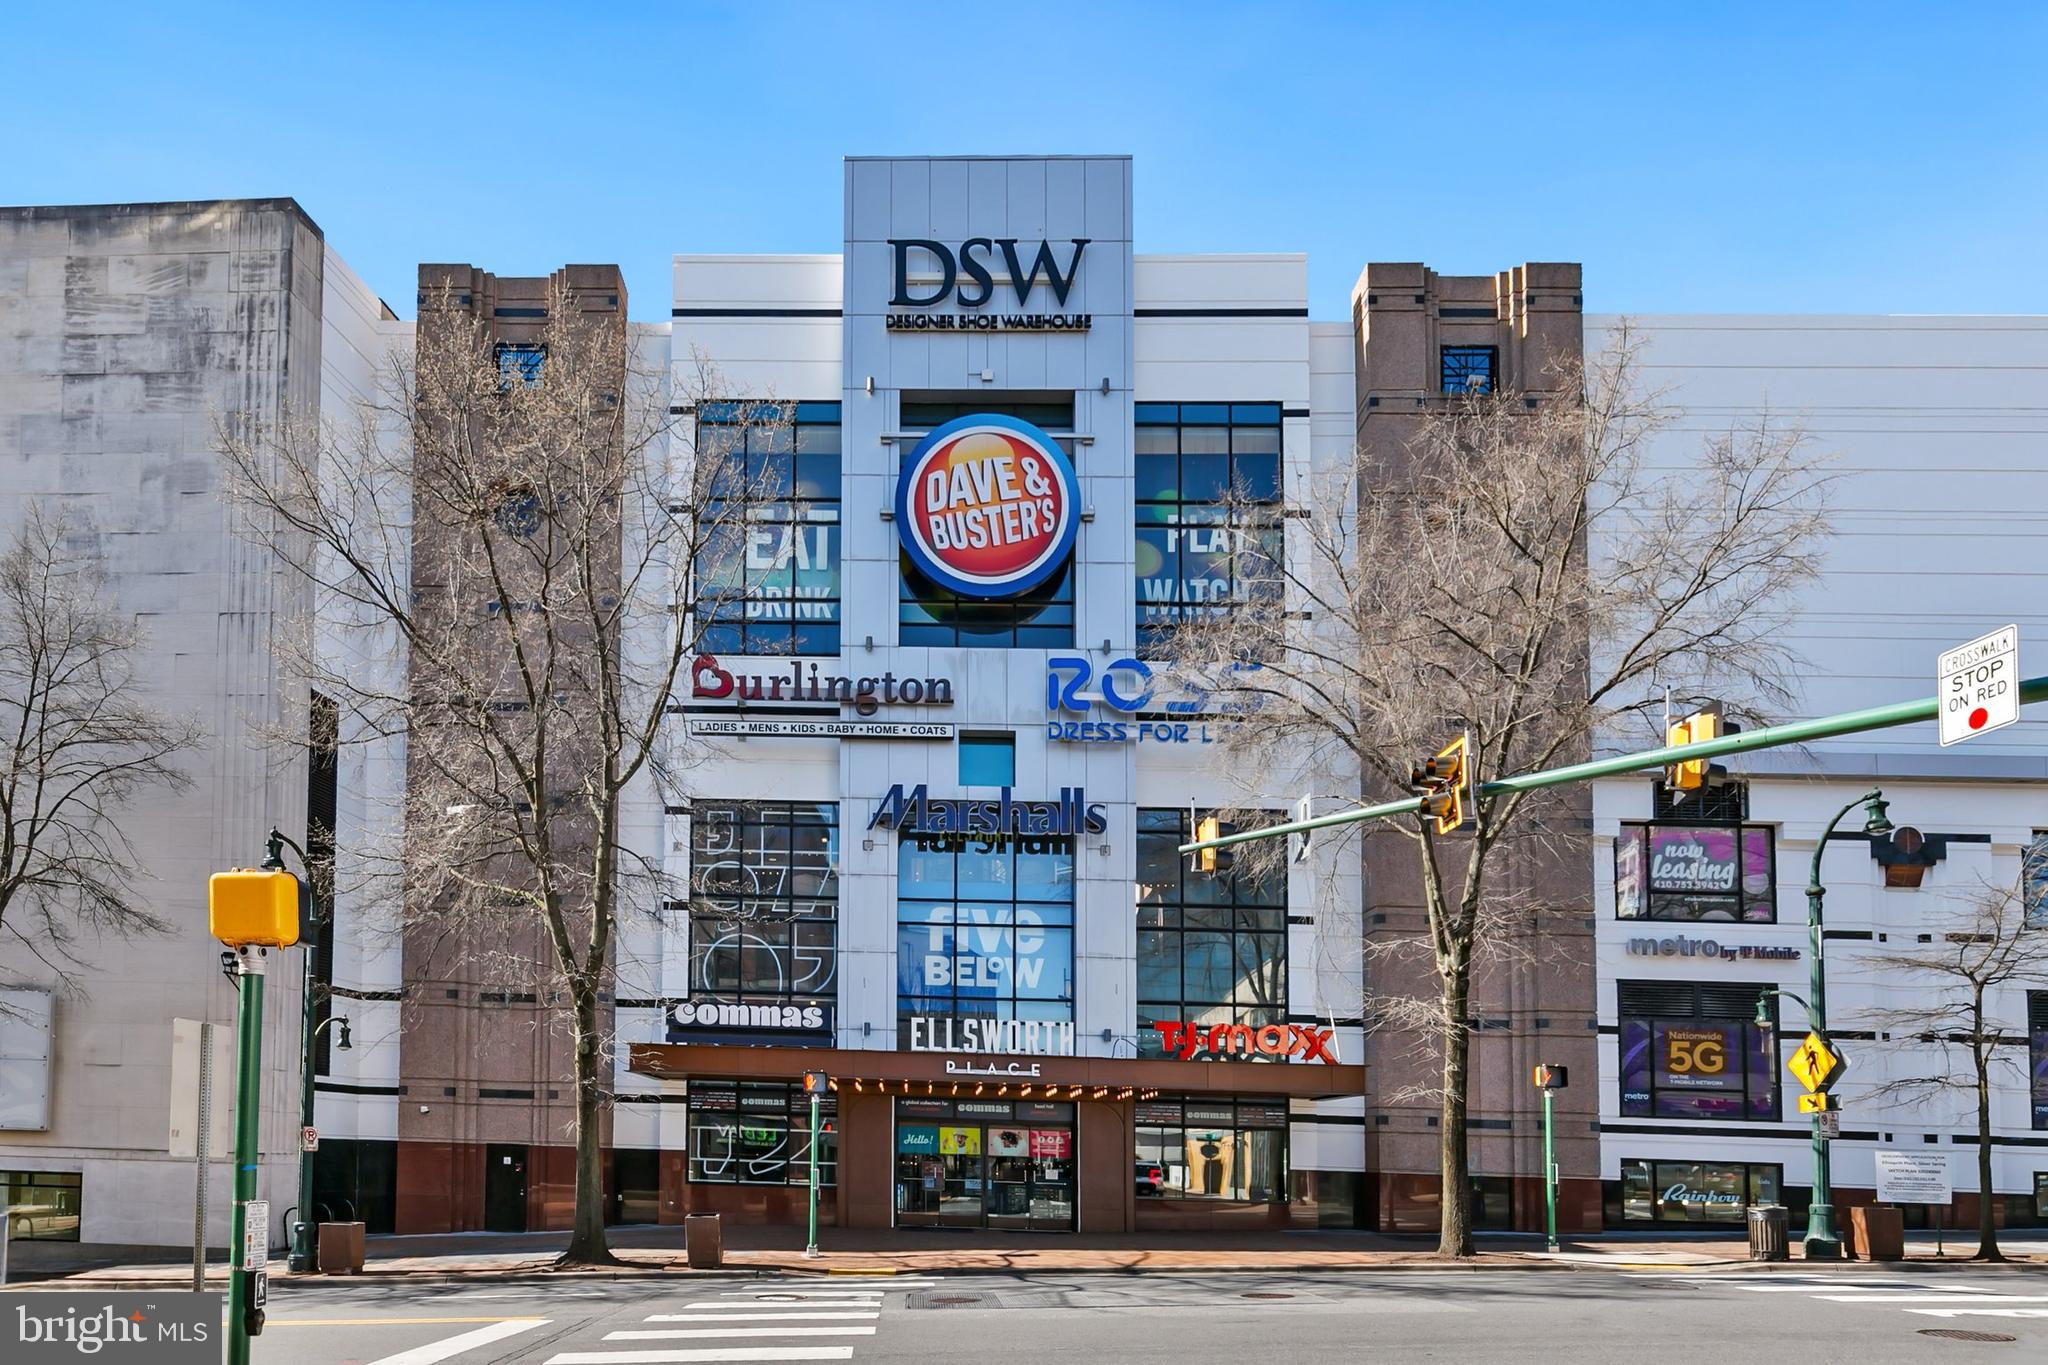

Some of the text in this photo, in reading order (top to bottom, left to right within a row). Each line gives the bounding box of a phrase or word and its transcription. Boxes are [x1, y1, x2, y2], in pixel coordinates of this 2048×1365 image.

[887, 238, 1092, 307] DSW
[886, 314, 1092, 329] DESIGNER SHOE WAREHOUSE
[926, 456, 1052, 513] DAVE &
[746, 507, 838, 570] EAT
[928, 498, 1055, 550] BUSTER'S
[746, 587, 832, 618] DRINK
[1945, 635, 2009, 673] CROSSWALK
[691, 653, 954, 716] Burlington
[1952, 659, 2004, 693] STOP
[1949, 680, 2007, 712] ON RED
[698, 723, 947, 735] LADIES MENS KIDS BABY HOME COATS
[1048, 721, 1127, 742] DRESS
[1139, 723, 1189, 744] FOR
[867, 784, 1107, 835] Marshalls
[1665, 844, 1704, 858] now
[1651, 854, 1735, 889] leasing
[925, 906, 1045, 954] five
[1626, 934, 1719, 958] metro
[1719, 945, 1737, 962] by
[924, 955, 1045, 989] BELOW
[675, 1003, 824, 1028] commas
[910, 1017, 1074, 1056] ELLSWORTH
[1668, 1030, 1722, 1041] Nationwide
[946, 1060, 1041, 1077] PLACE
[1669, 1041, 1724, 1073] 5G
[741, 1097, 786, 1106] commas
[957, 1103, 1010, 1113] commas
[1625, 1092, 1649, 1100] metro
[1186, 1111, 1233, 1120] commas
[903, 1134, 933, 1145] Hello!
[1663, 1183, 1740, 1203] Rainbow
